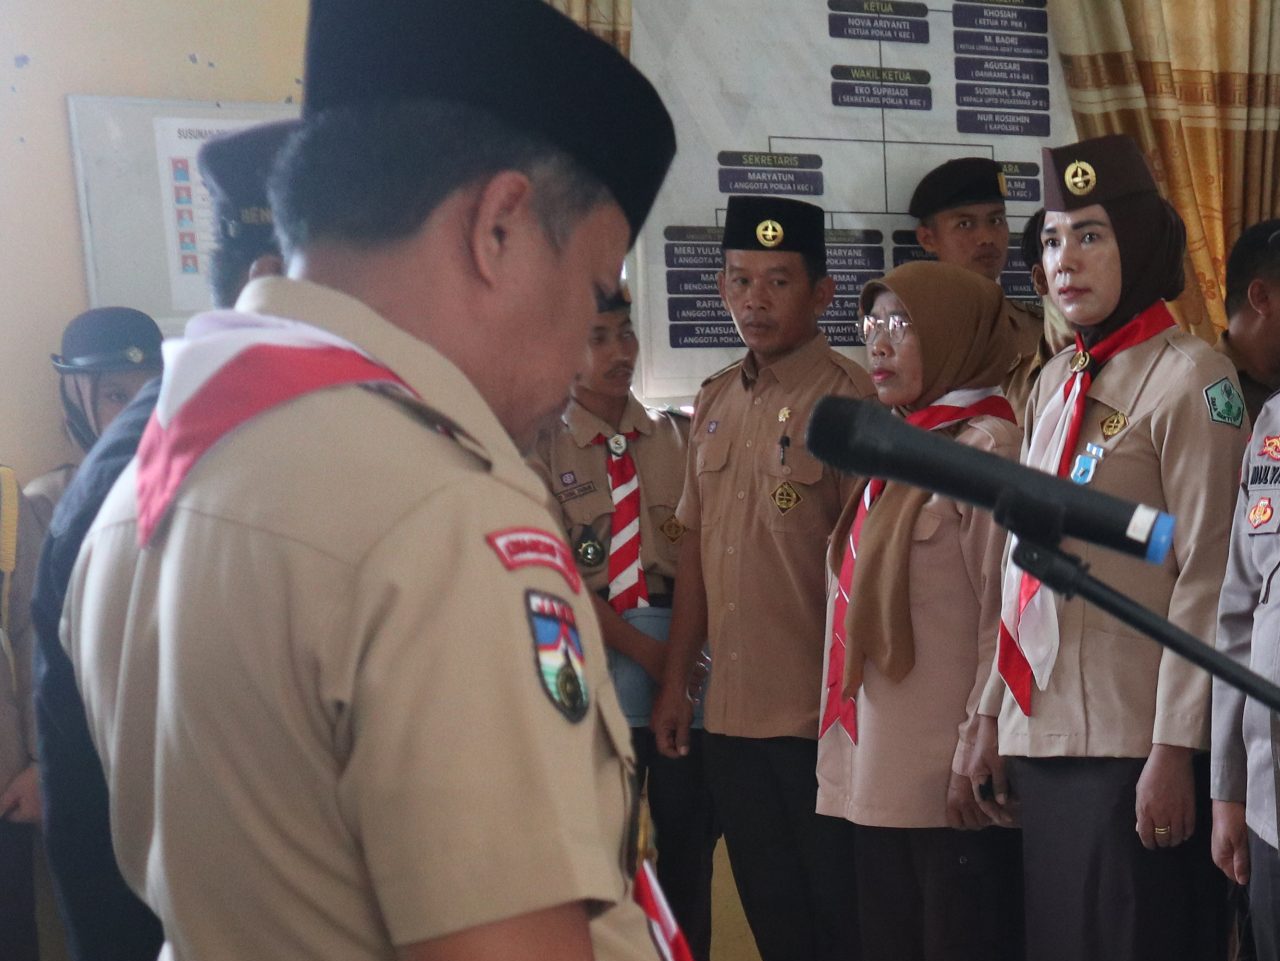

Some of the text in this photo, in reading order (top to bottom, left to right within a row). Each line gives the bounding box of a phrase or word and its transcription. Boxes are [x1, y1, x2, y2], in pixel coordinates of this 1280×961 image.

[863, 1, 893, 13] KETUA
[848, 17, 910, 30] NOVA ARIYANTI
[995, 36, 1018, 45] BADRI
[983, 61, 1020, 71] AGUSSARI
[851, 68, 911, 82] WAKIL KETUA
[855, 85, 909, 97] EKO SUPRIADI
[977, 113, 994, 122] NUR
[742, 155, 799, 167] SEKRETARIS
[747, 172, 794, 182] MARYATUN
[735, 182, 768, 191] ANGGOTA
[673, 246, 695, 255] MERI
[826, 248, 862, 257] HARYANI
[678, 256, 713, 264] ANGGOTA
[833, 274, 857, 282] RMAN
[681, 310, 716, 319] ANGGOTA
[695, 326, 738, 336] SYAMSUA
[827, 325, 857, 334] WAHYU
[683, 336, 718, 345] ANGGOTA
